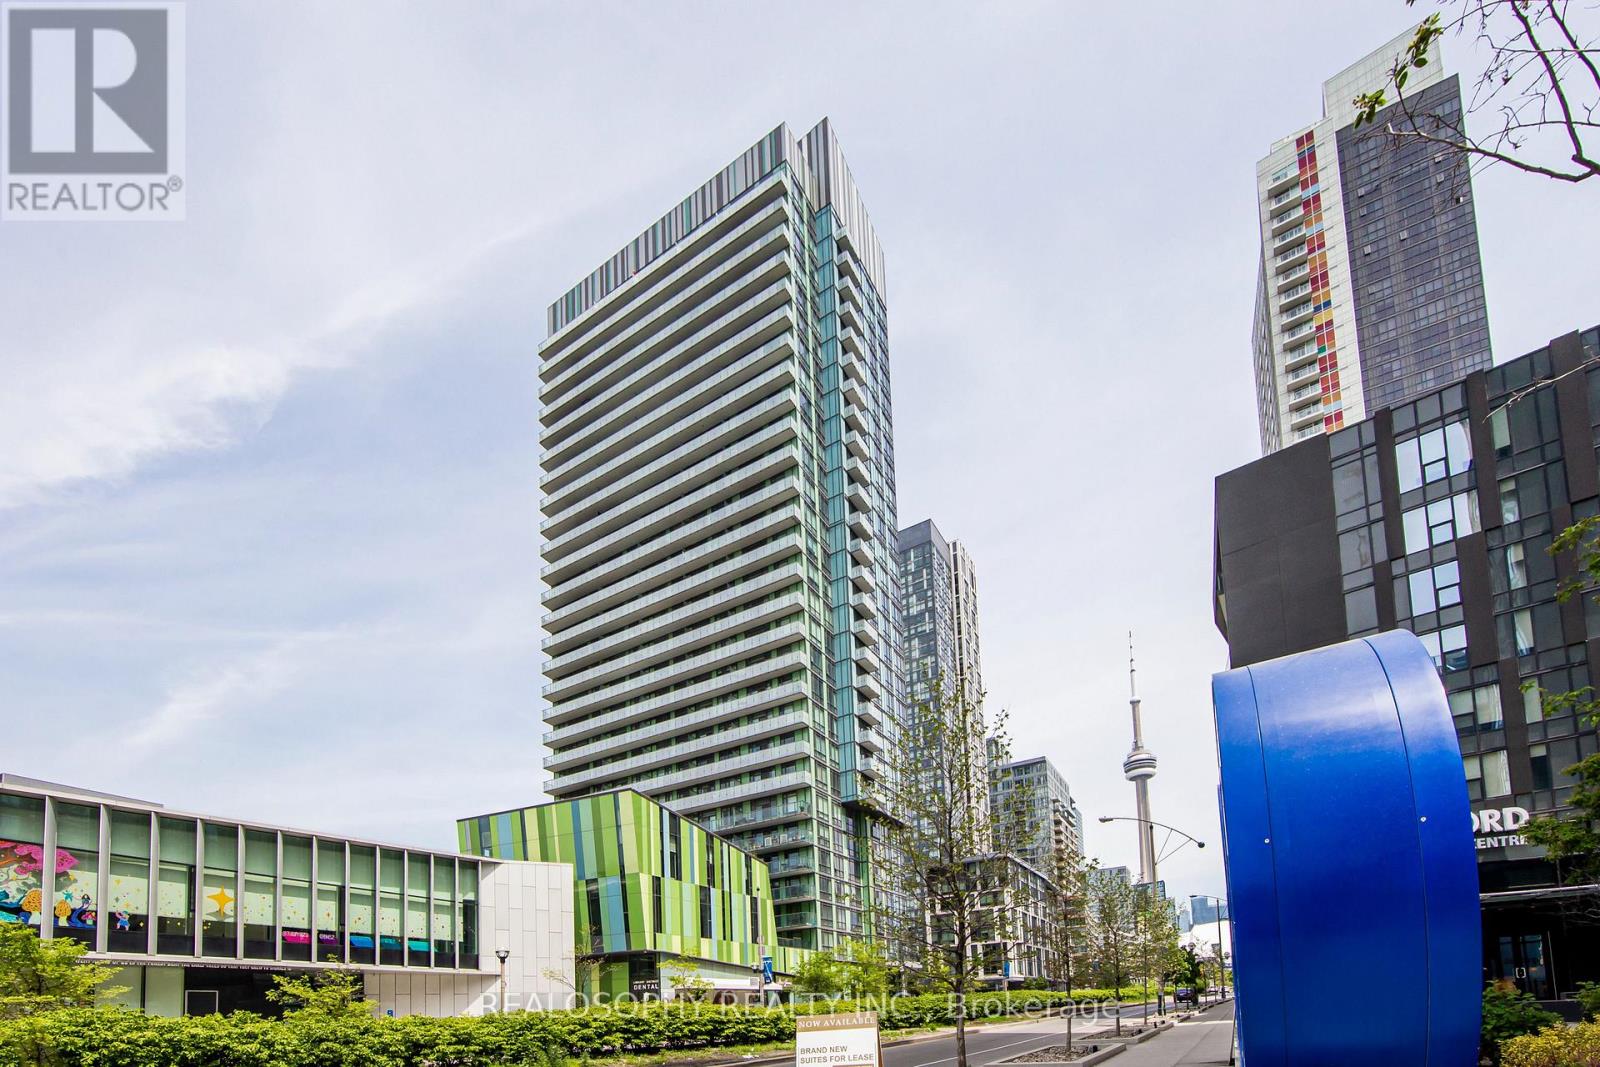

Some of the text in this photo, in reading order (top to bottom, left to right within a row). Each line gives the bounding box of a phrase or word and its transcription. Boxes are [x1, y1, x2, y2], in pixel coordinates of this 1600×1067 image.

[798, 1016, 876, 1029] NOW AVAILABLE
[800, 1045, 848, 1055] BRAND NEW
[800, 1053, 874, 1064] SUITES FOR LEASE
